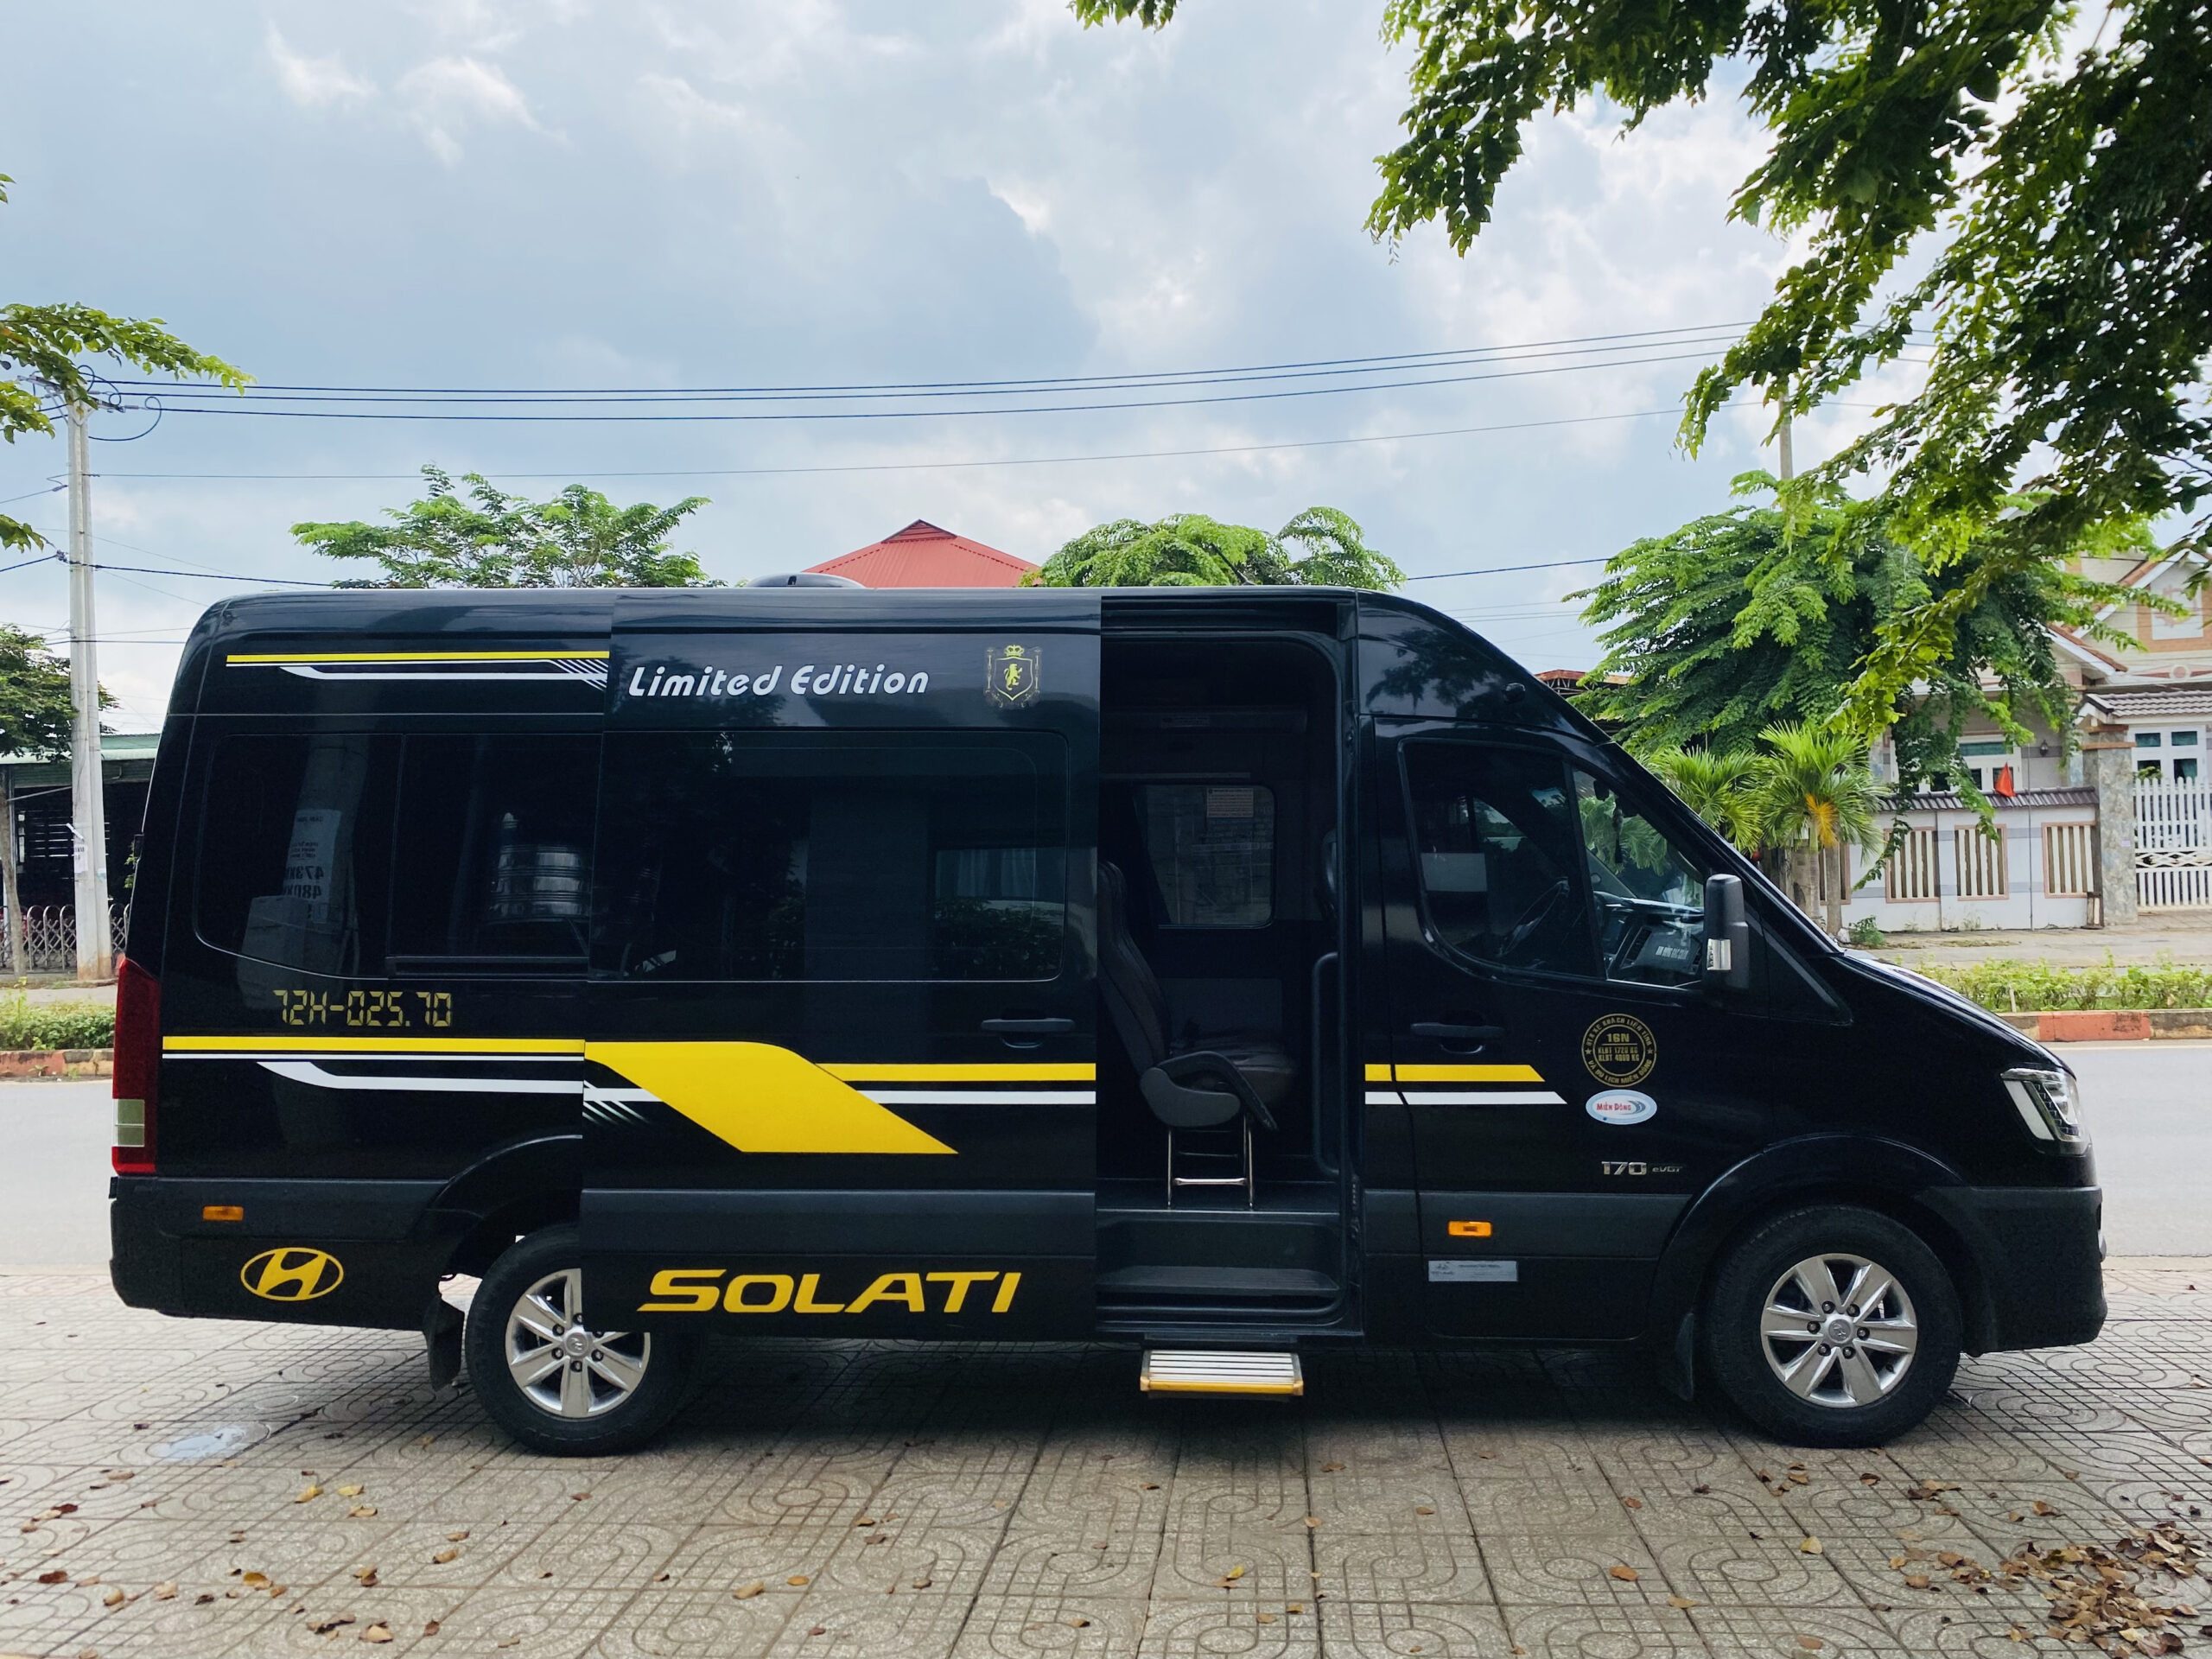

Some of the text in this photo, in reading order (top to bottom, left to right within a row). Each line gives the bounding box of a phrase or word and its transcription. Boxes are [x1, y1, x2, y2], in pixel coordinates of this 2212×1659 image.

[628, 664, 931, 697] Limited Edition
[1606, 1033, 1630, 1043] 16N
[1601, 1161, 1647, 1175] 170
[637, 1269, 1021, 1313] SOLATI
